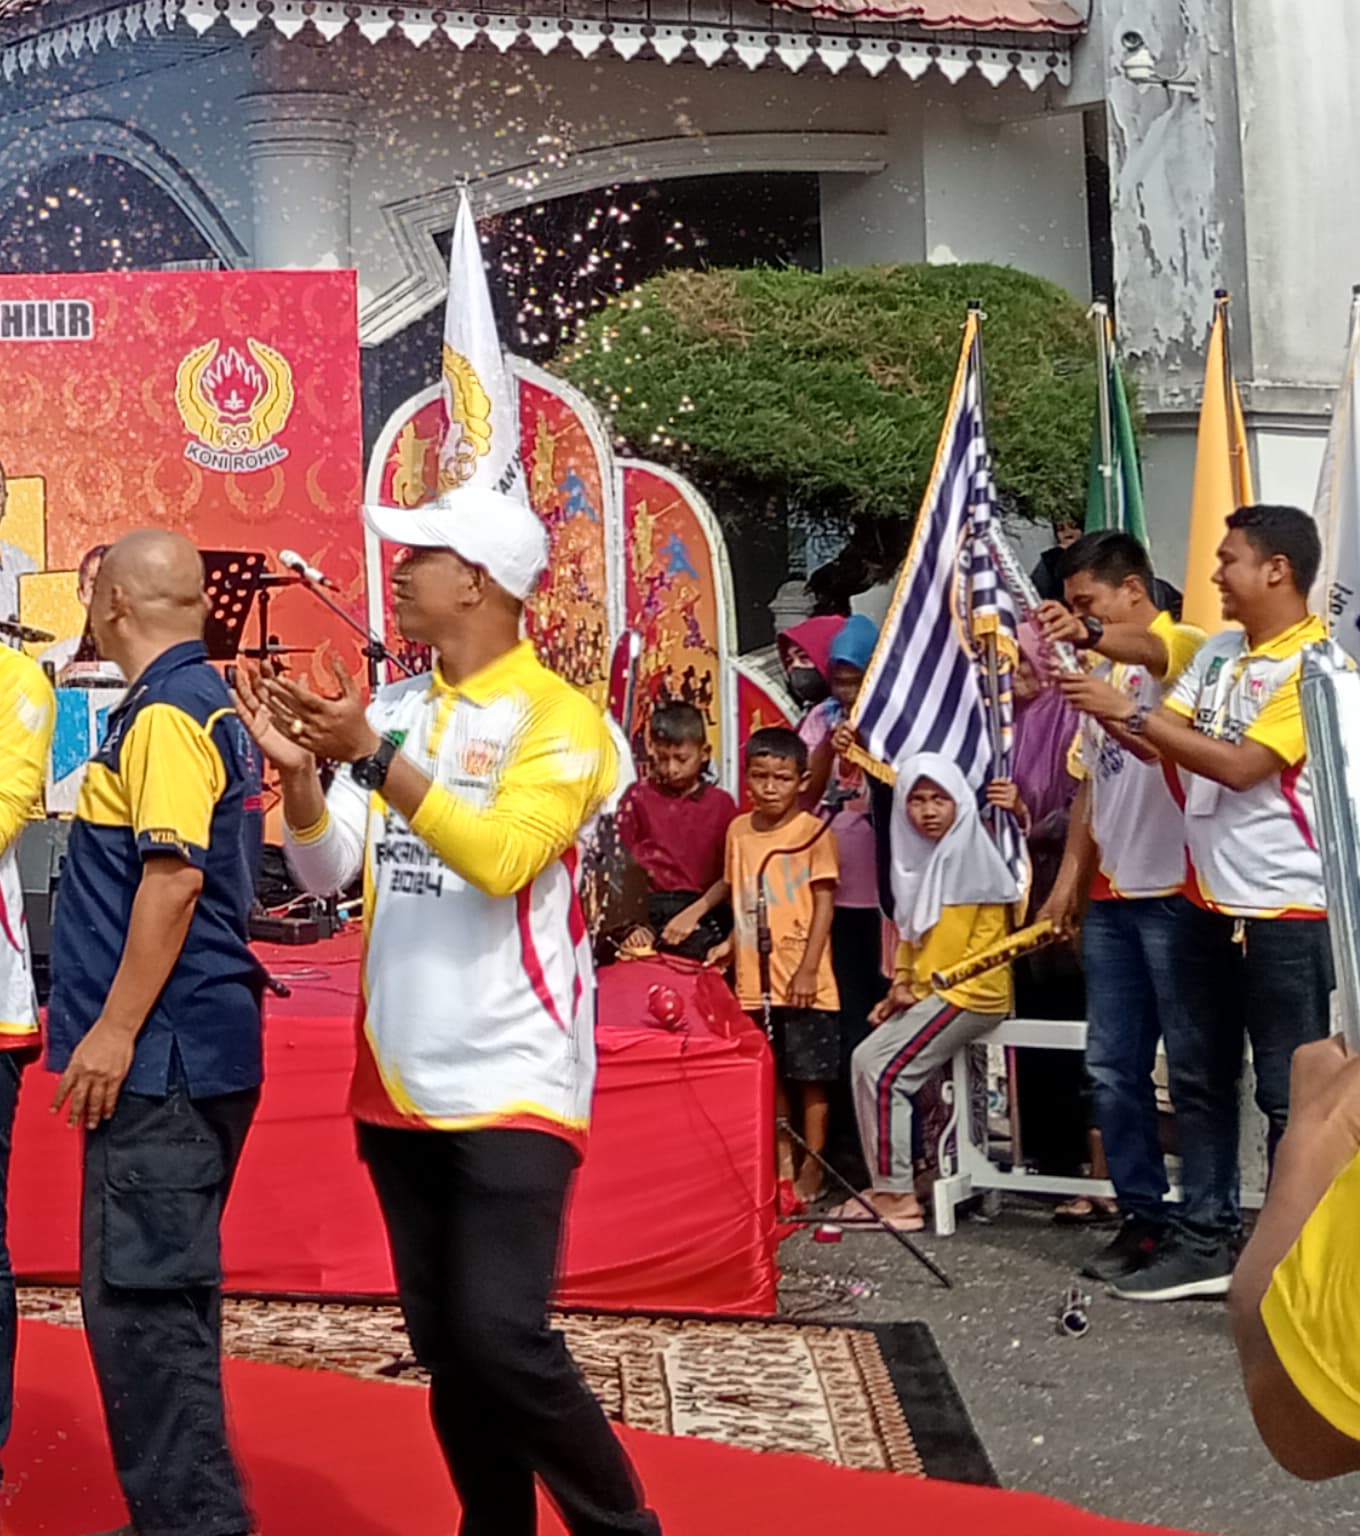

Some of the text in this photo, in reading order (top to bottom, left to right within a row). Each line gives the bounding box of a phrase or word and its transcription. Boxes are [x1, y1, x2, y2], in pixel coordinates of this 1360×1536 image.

[0, 302, 92, 338] HILIR
[186, 443, 286, 470] KONI ROHIL
[390, 869, 444, 897] 2024
